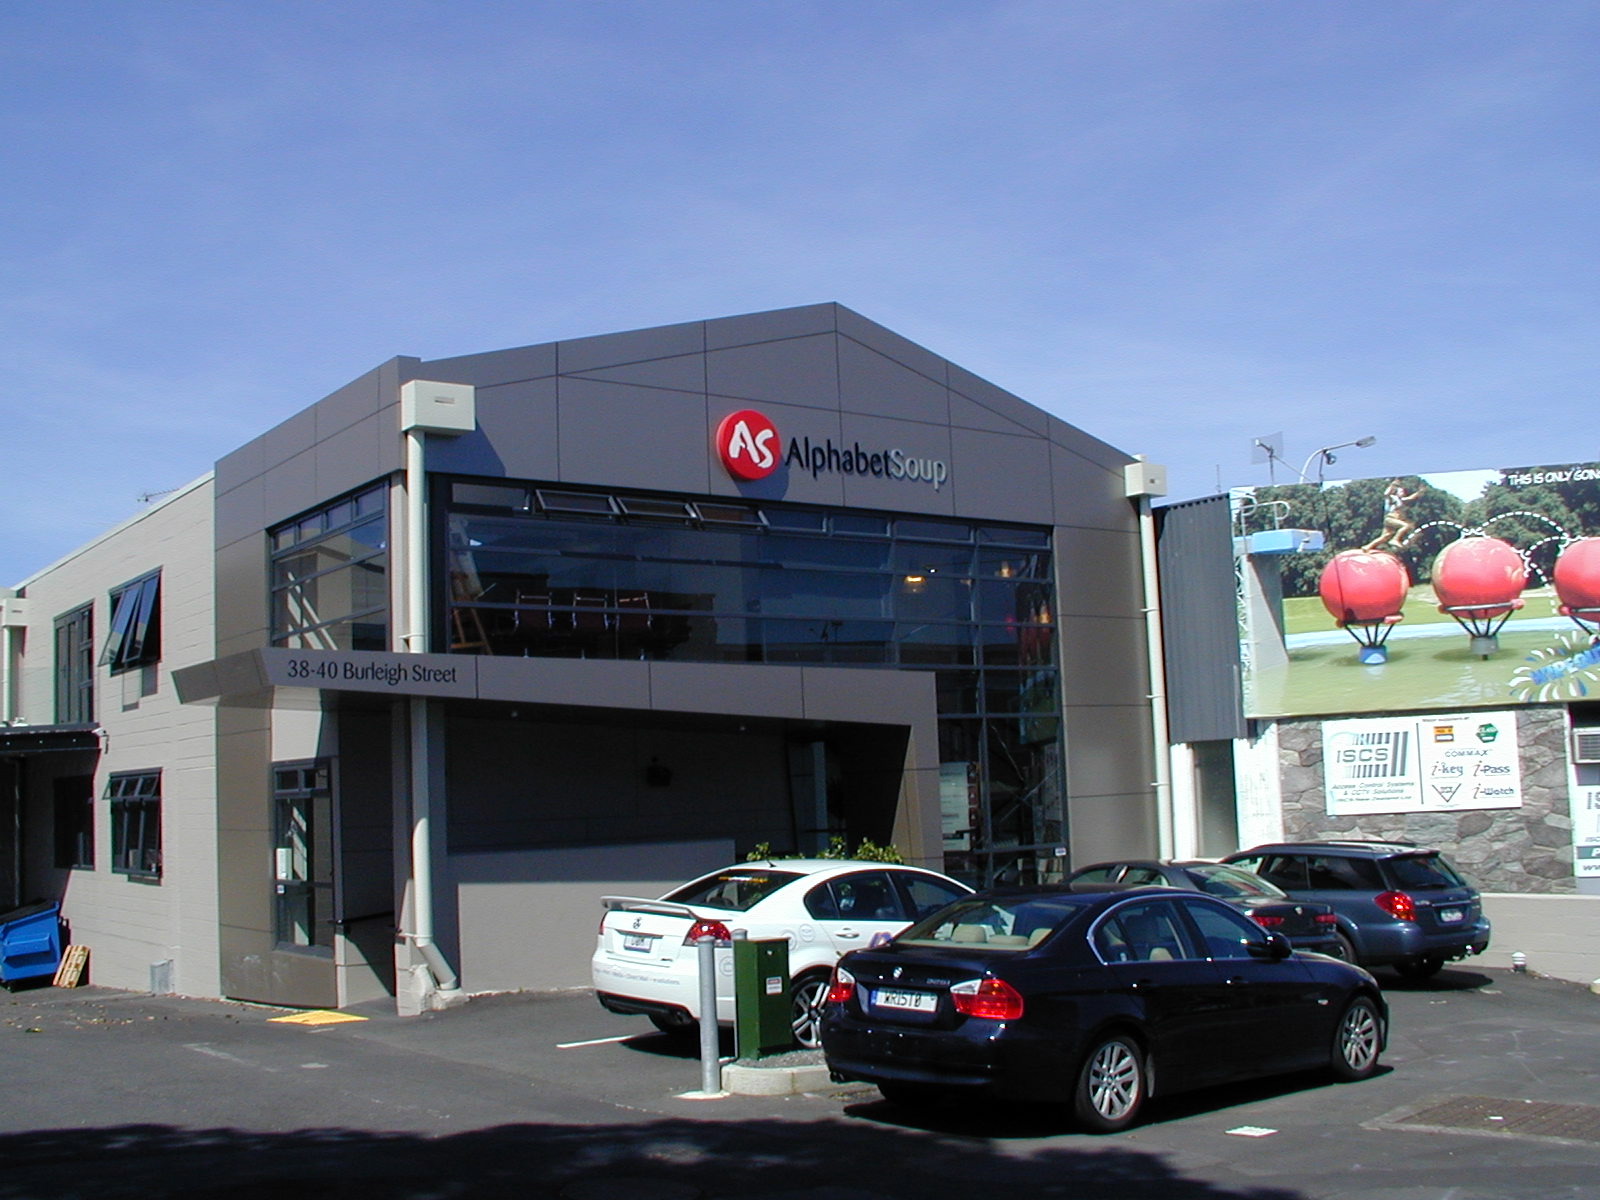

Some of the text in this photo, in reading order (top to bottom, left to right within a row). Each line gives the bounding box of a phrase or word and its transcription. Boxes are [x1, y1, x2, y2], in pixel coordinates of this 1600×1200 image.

[729, 420, 774, 468] AS
[785, 436, 948, 491] AlphabetSoup
[1545, 470, 1573, 483] ONLY
[287, 659, 457, 686] 38-40 Burleigh Street
